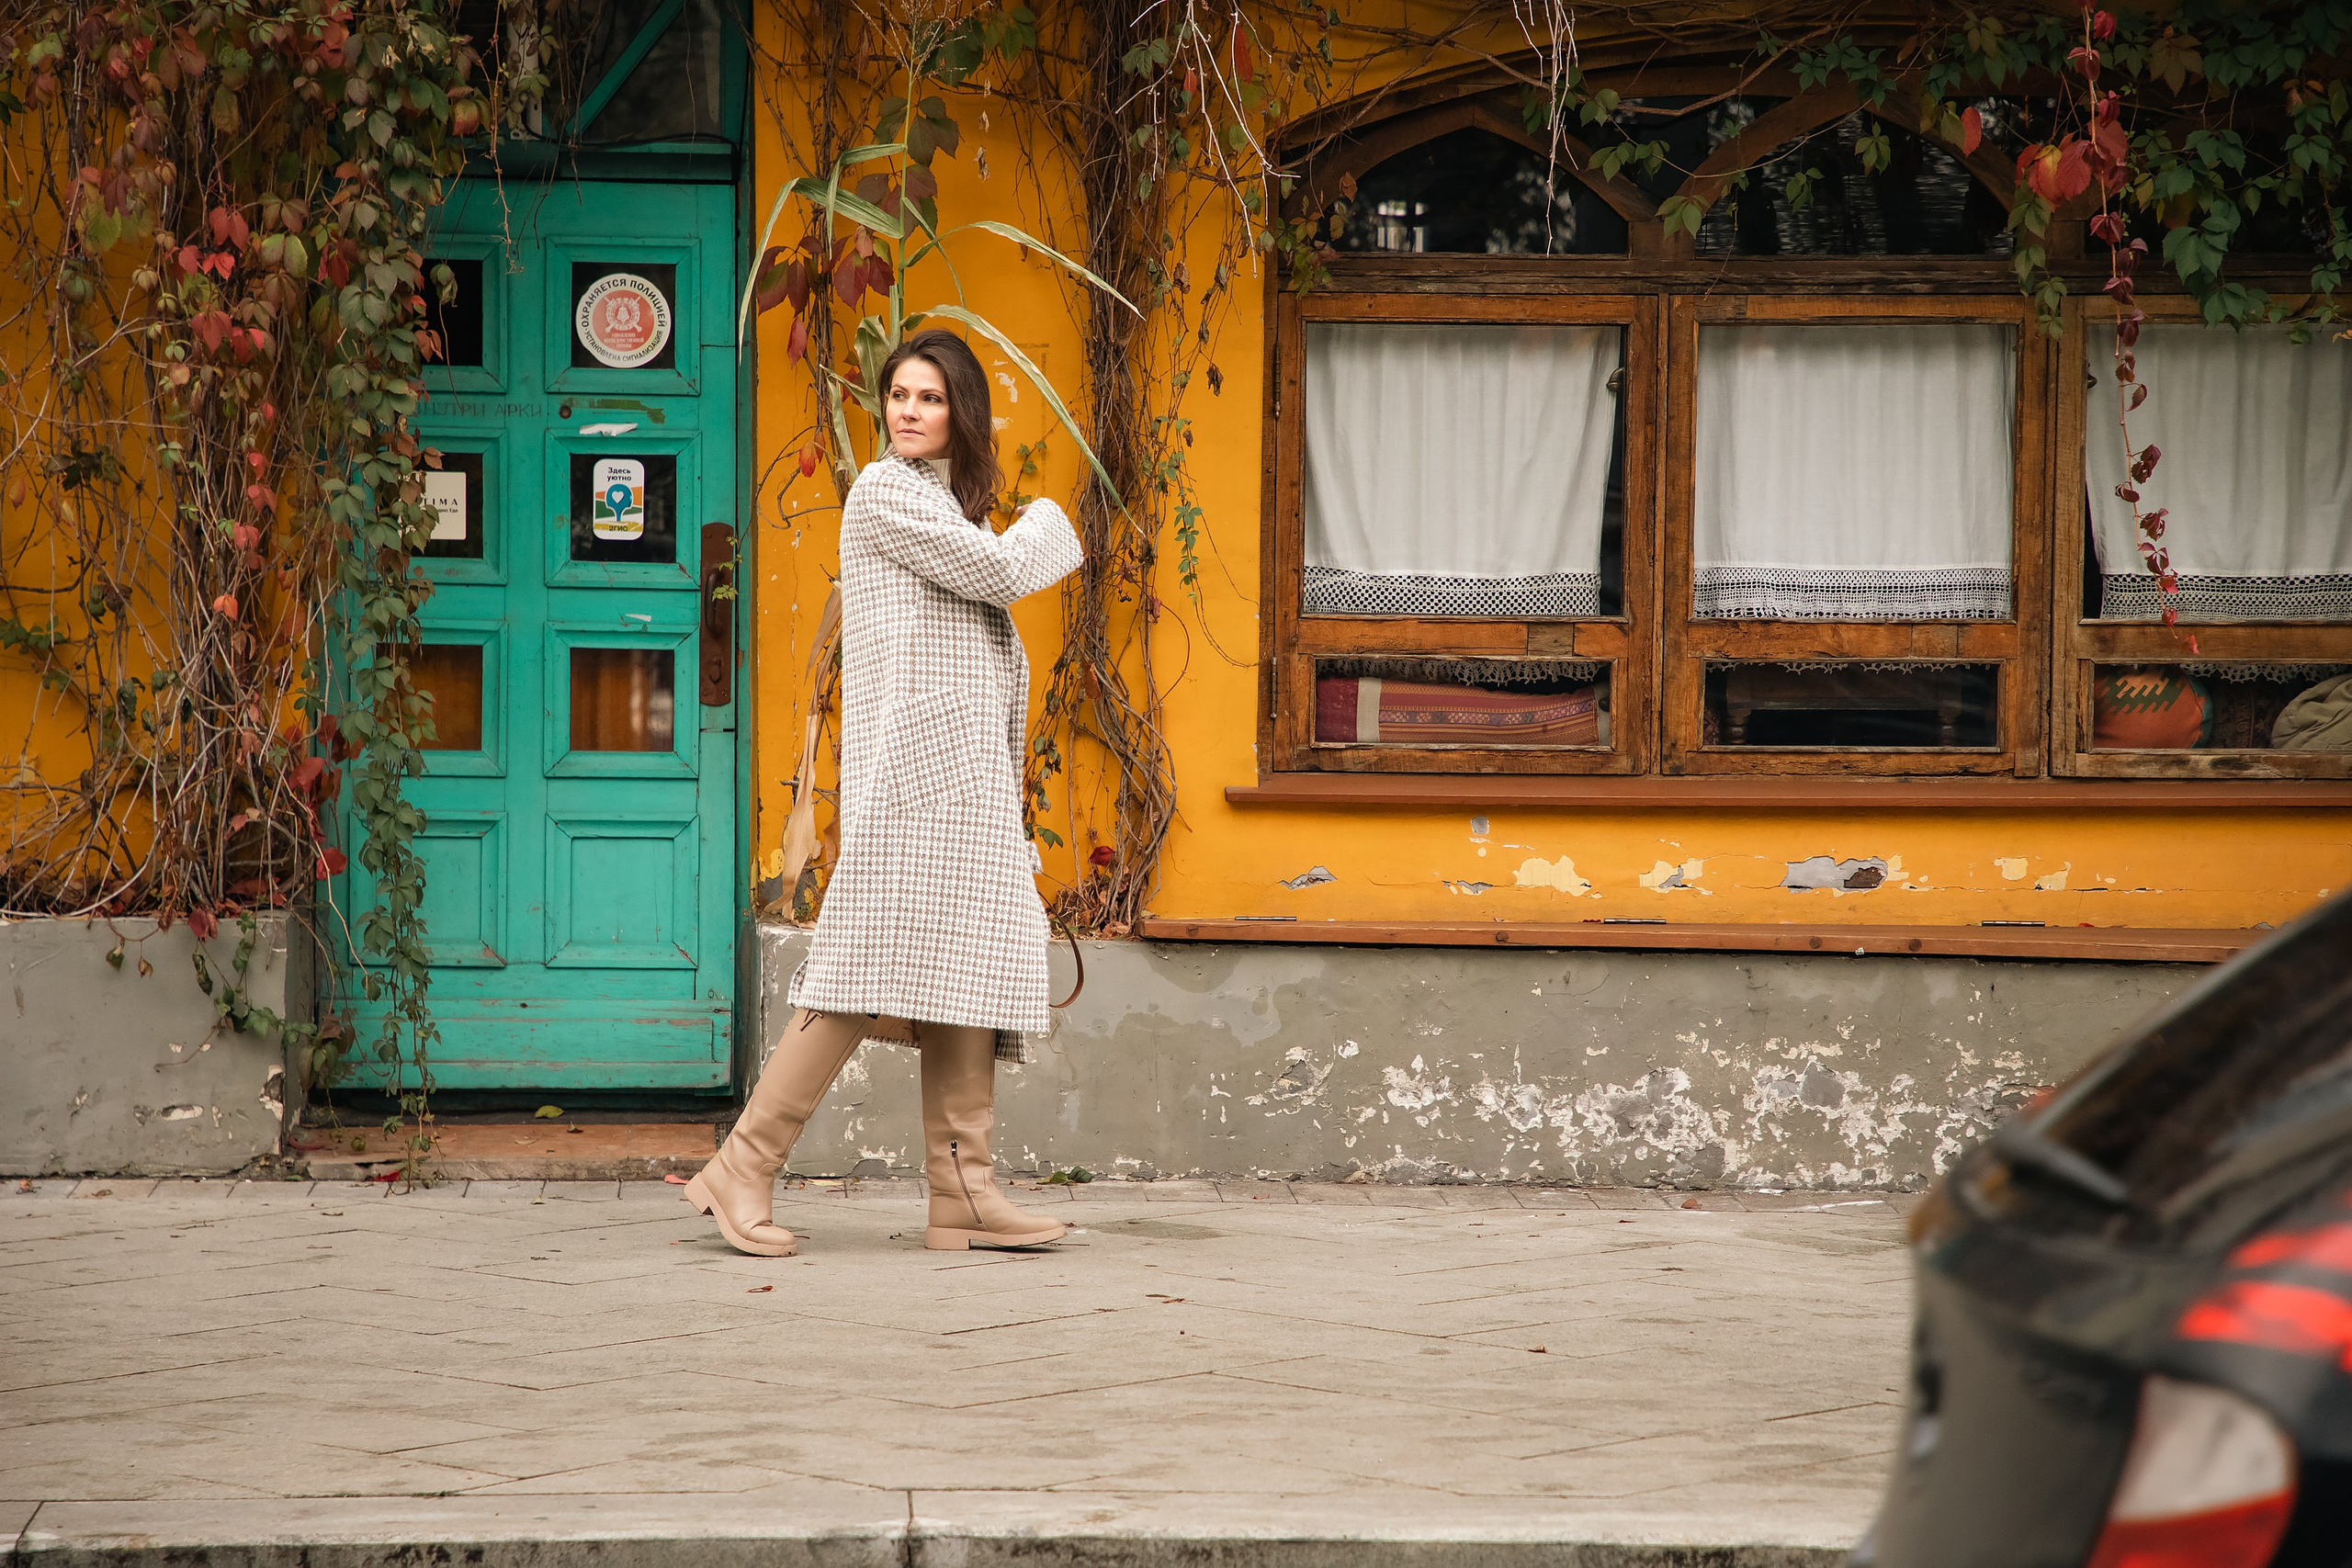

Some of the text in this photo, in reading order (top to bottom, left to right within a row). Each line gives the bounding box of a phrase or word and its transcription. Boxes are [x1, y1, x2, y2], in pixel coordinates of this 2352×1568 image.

[581, 278, 668, 328] ОХРАНЯЕТСЯ ПОЛИЦИЕЙ
[583, 330, 663, 362] УСТАНОВЛЕНА СИГНАЛИЗАЦИЯ
[494, 402, 542, 417] АРКИ
